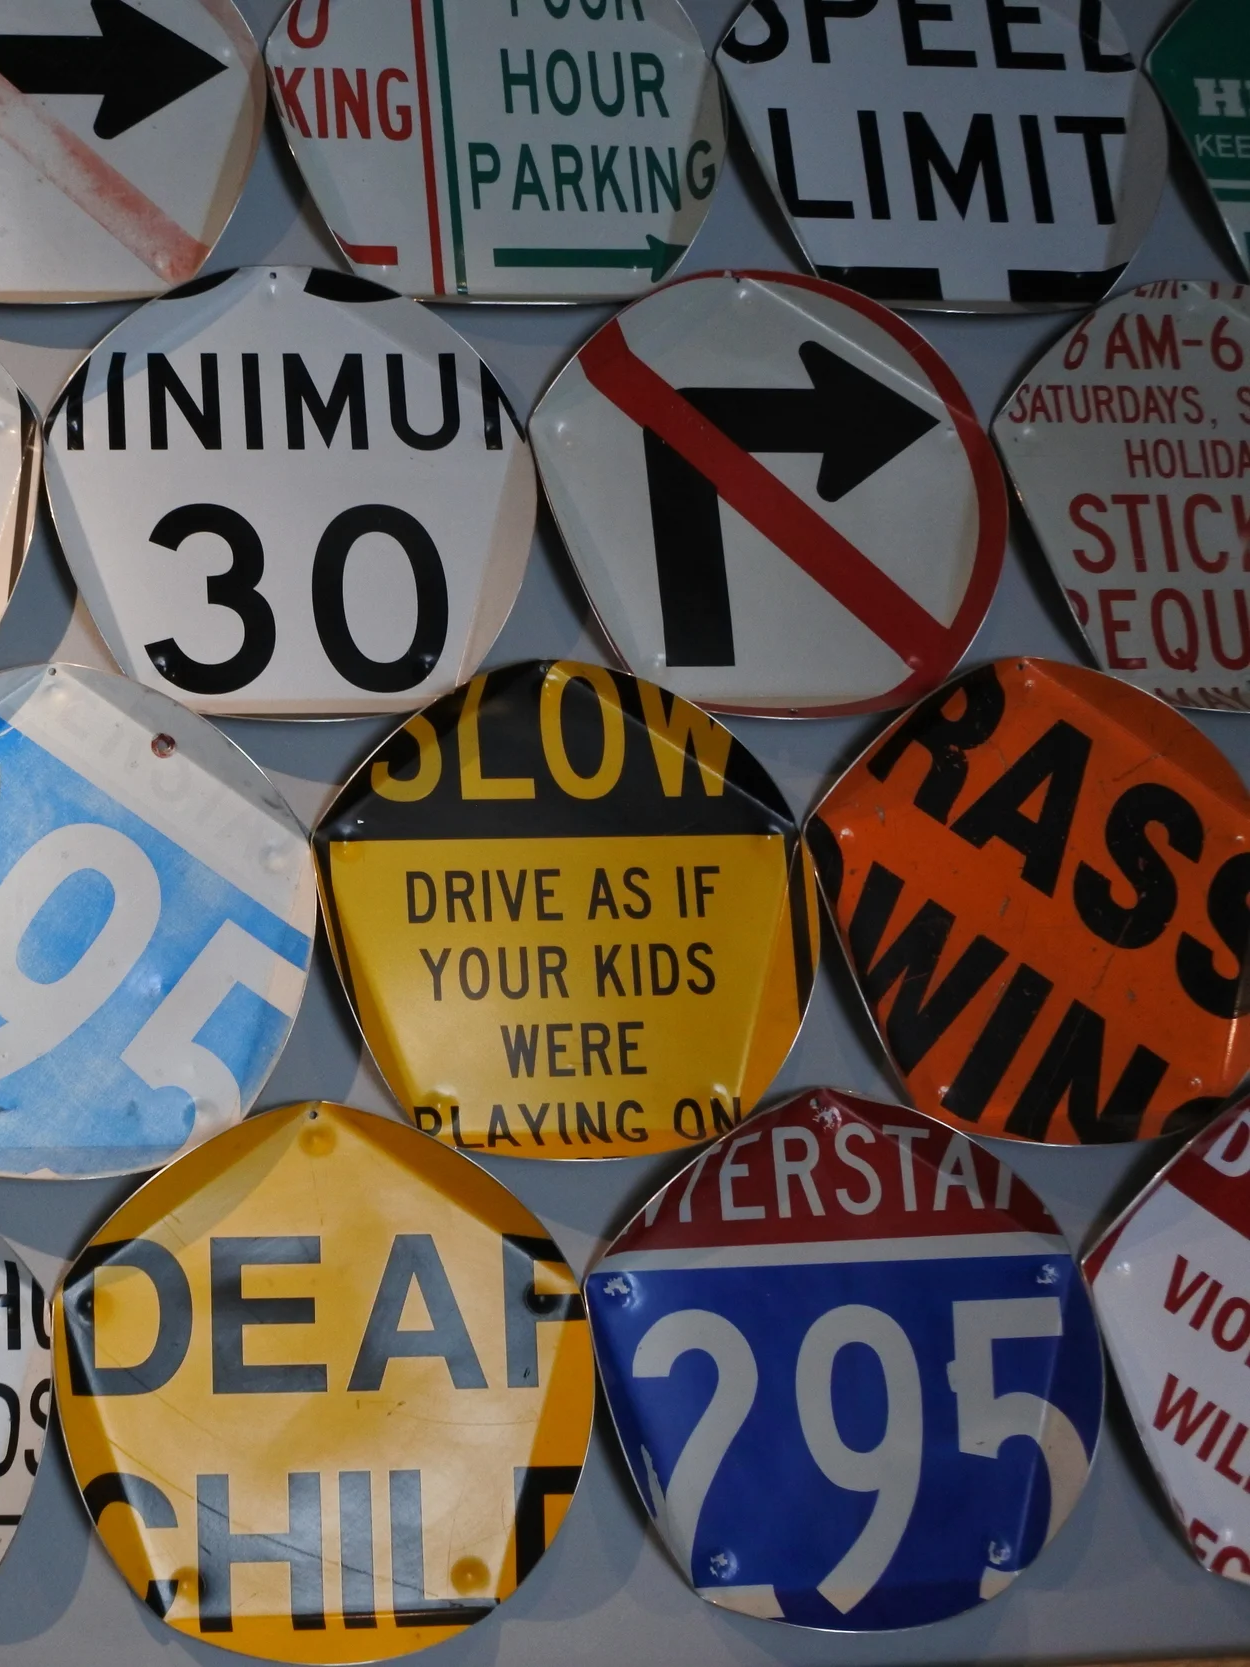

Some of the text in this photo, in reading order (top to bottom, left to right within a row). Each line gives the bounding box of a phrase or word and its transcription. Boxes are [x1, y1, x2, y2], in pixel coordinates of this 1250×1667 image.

[270, 66, 414, 142] KING
[499, 48, 671, 119] HOUR
[467, 139, 716, 214] PARKING
[767, 107, 1127, 226] LIMIT
[1062, 312, 1096, 370] 6
[1008, 383, 1218, 429] SATURDAYS,
[144, 502, 449, 695] 30
[405, 865, 721, 924] DRIVE AS IF
[419, 942, 717, 1002] YOUR KIDS
[500, 1020, 649, 1079] WERE
[414, 1097, 743, 1149] PLAYING ON
[1163, 1254, 1250, 1369] VIO
[632, 1296, 1091, 1618] 295
[1153, 1372, 1250, 1494] WIL
